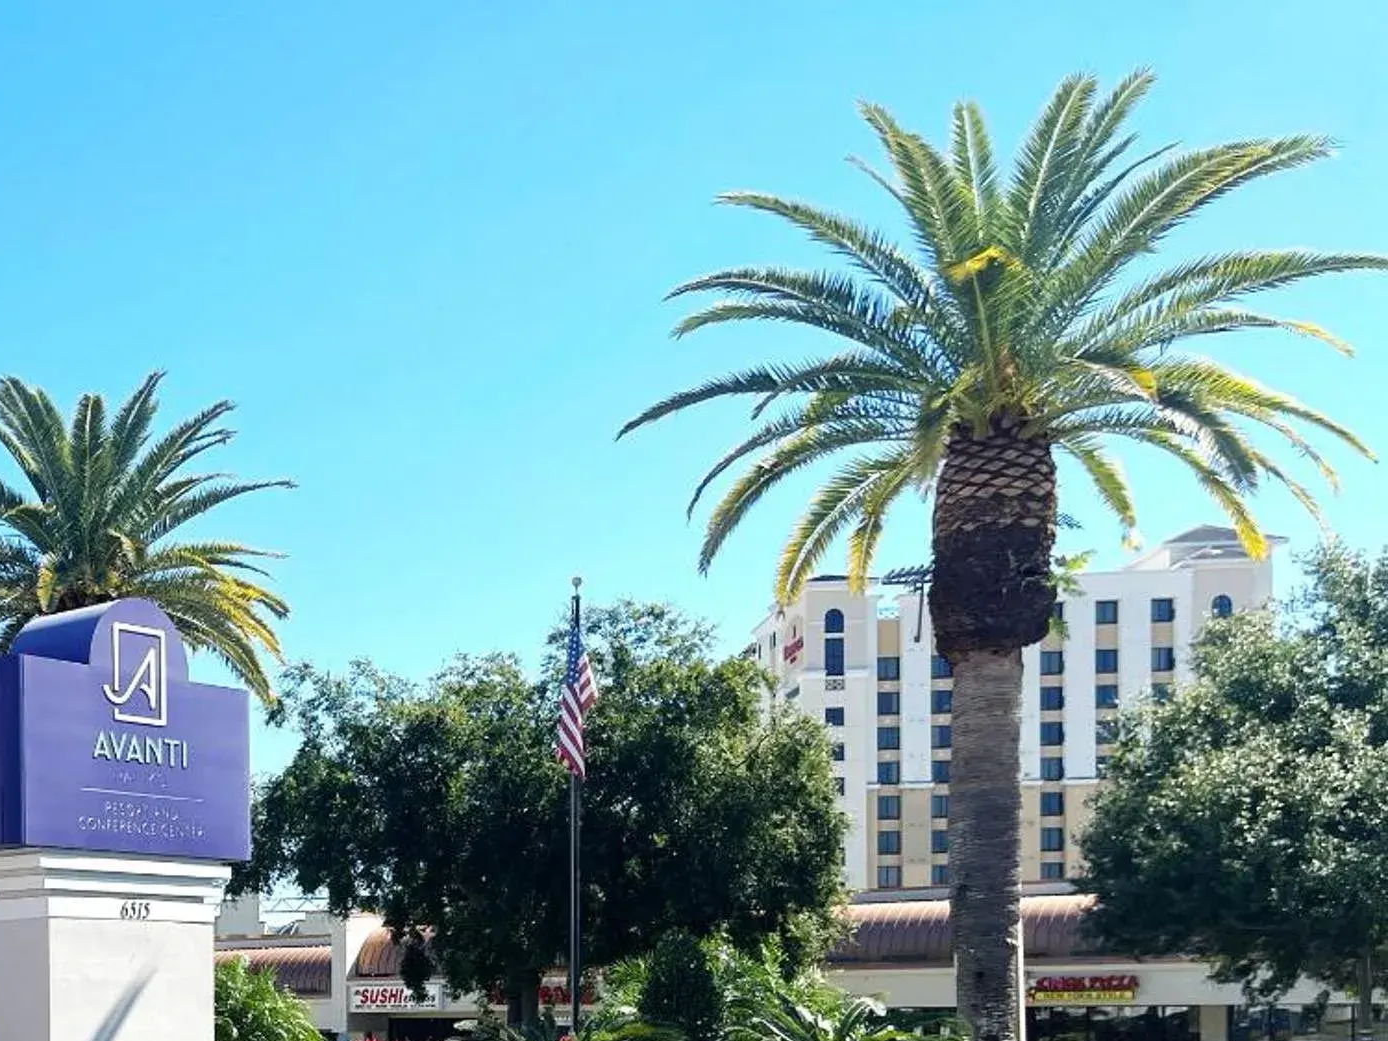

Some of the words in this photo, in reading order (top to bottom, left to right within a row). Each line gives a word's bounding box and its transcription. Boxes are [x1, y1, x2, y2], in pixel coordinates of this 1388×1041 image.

[93, 729, 189, 768] AVANTI
[78, 815, 157, 836] CONFERENCE
[120, 901, 151, 920] 6515
[359, 987, 404, 1004] SUSHI
